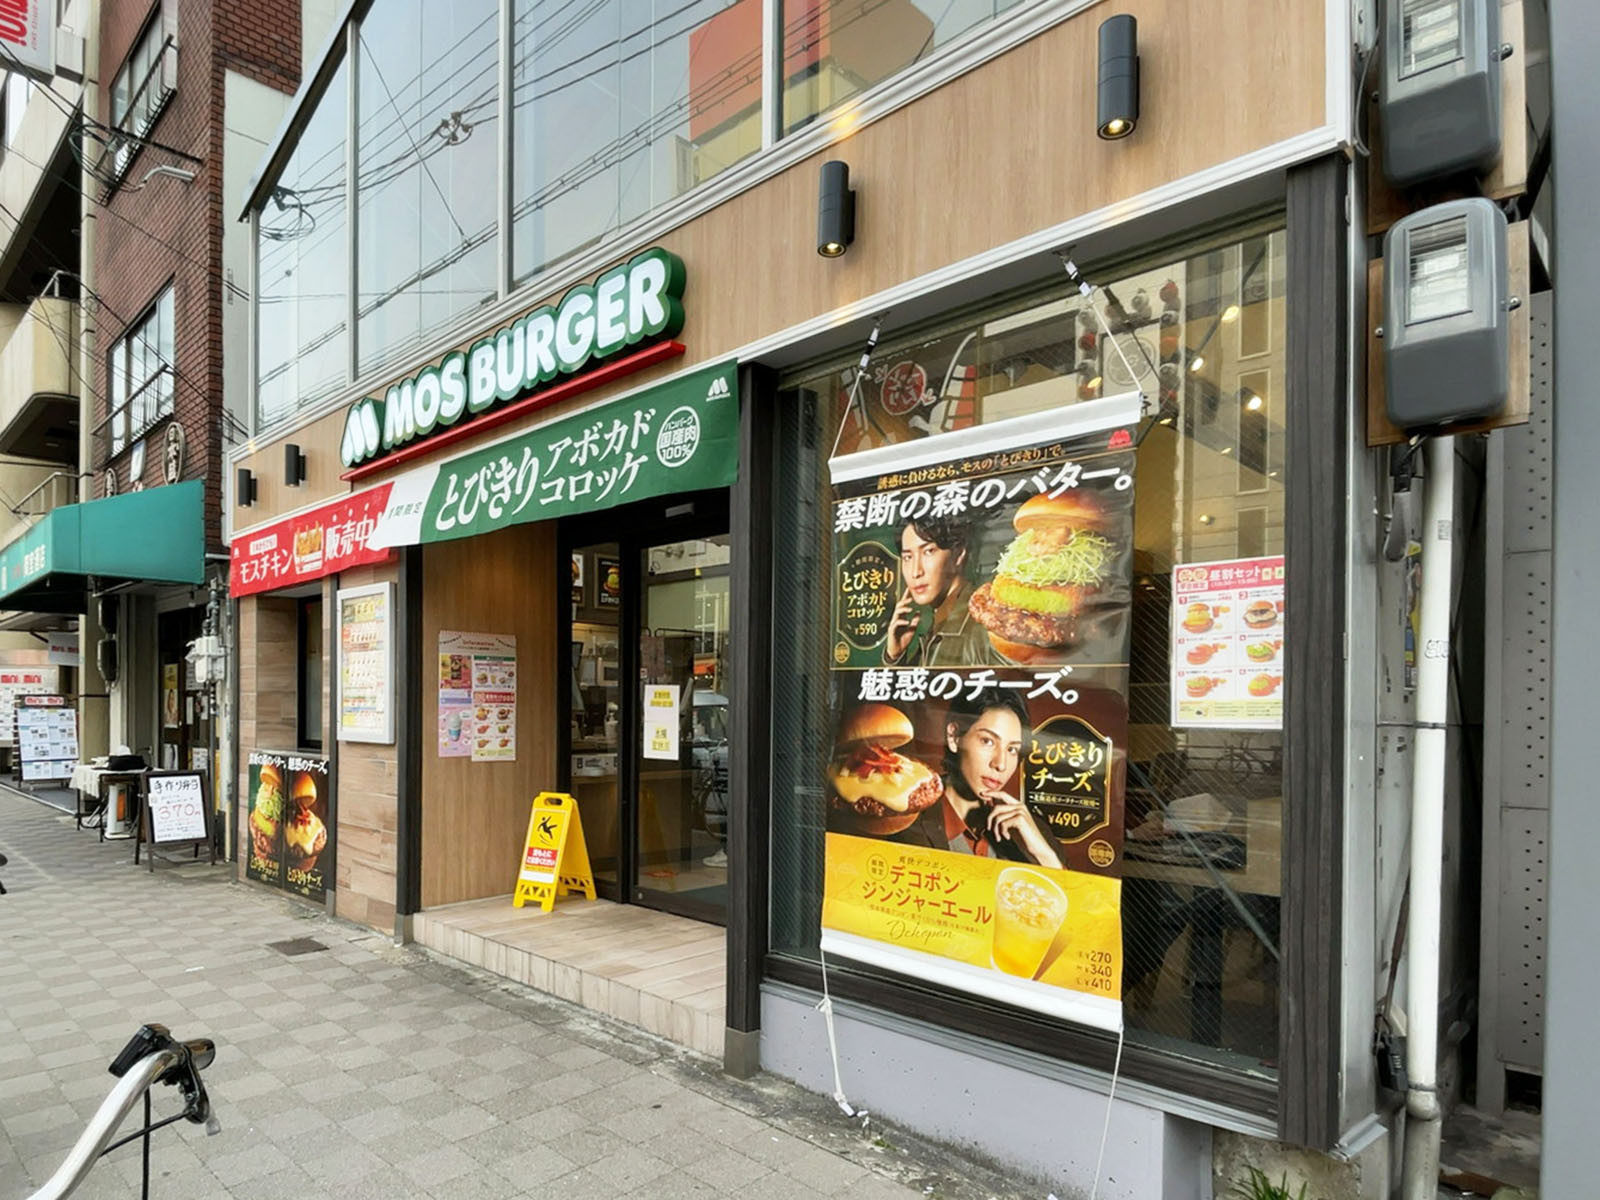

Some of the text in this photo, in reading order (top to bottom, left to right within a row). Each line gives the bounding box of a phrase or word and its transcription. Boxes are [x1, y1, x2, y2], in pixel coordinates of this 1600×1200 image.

[385, 356, 466, 443] MOS
[471, 257, 666, 407] BURGER
[664, 414, 694, 431] ハンバーグ
[544, 408, 657, 477] アボカド
[660, 424, 697, 447] 国産肉
[661, 443, 693, 460] 100%
[435, 446, 540, 531] とびきり
[540, 451, 649, 506] コロッケ
[834, 461, 1132, 533] 禁断の森のバター。
[387, 501, 423, 520] 間限定
[240, 550, 294, 584] モスチキン
[842, 567, 895, 592] とびきり
[847, 592, 888, 607] アボカド
[847, 605, 885, 619] コロッケ
[855, 623, 877, 635] ¥590
[23, 674, 42, 683] mini
[858, 665, 1079, 704] 魅惑のチーズ。
[1028, 740, 1103, 769] とびきり
[1032, 767, 1095, 792] チーズ
[1048, 811, 1080, 828] ¥490
[862, 881, 992, 924] ジンジャーエール
